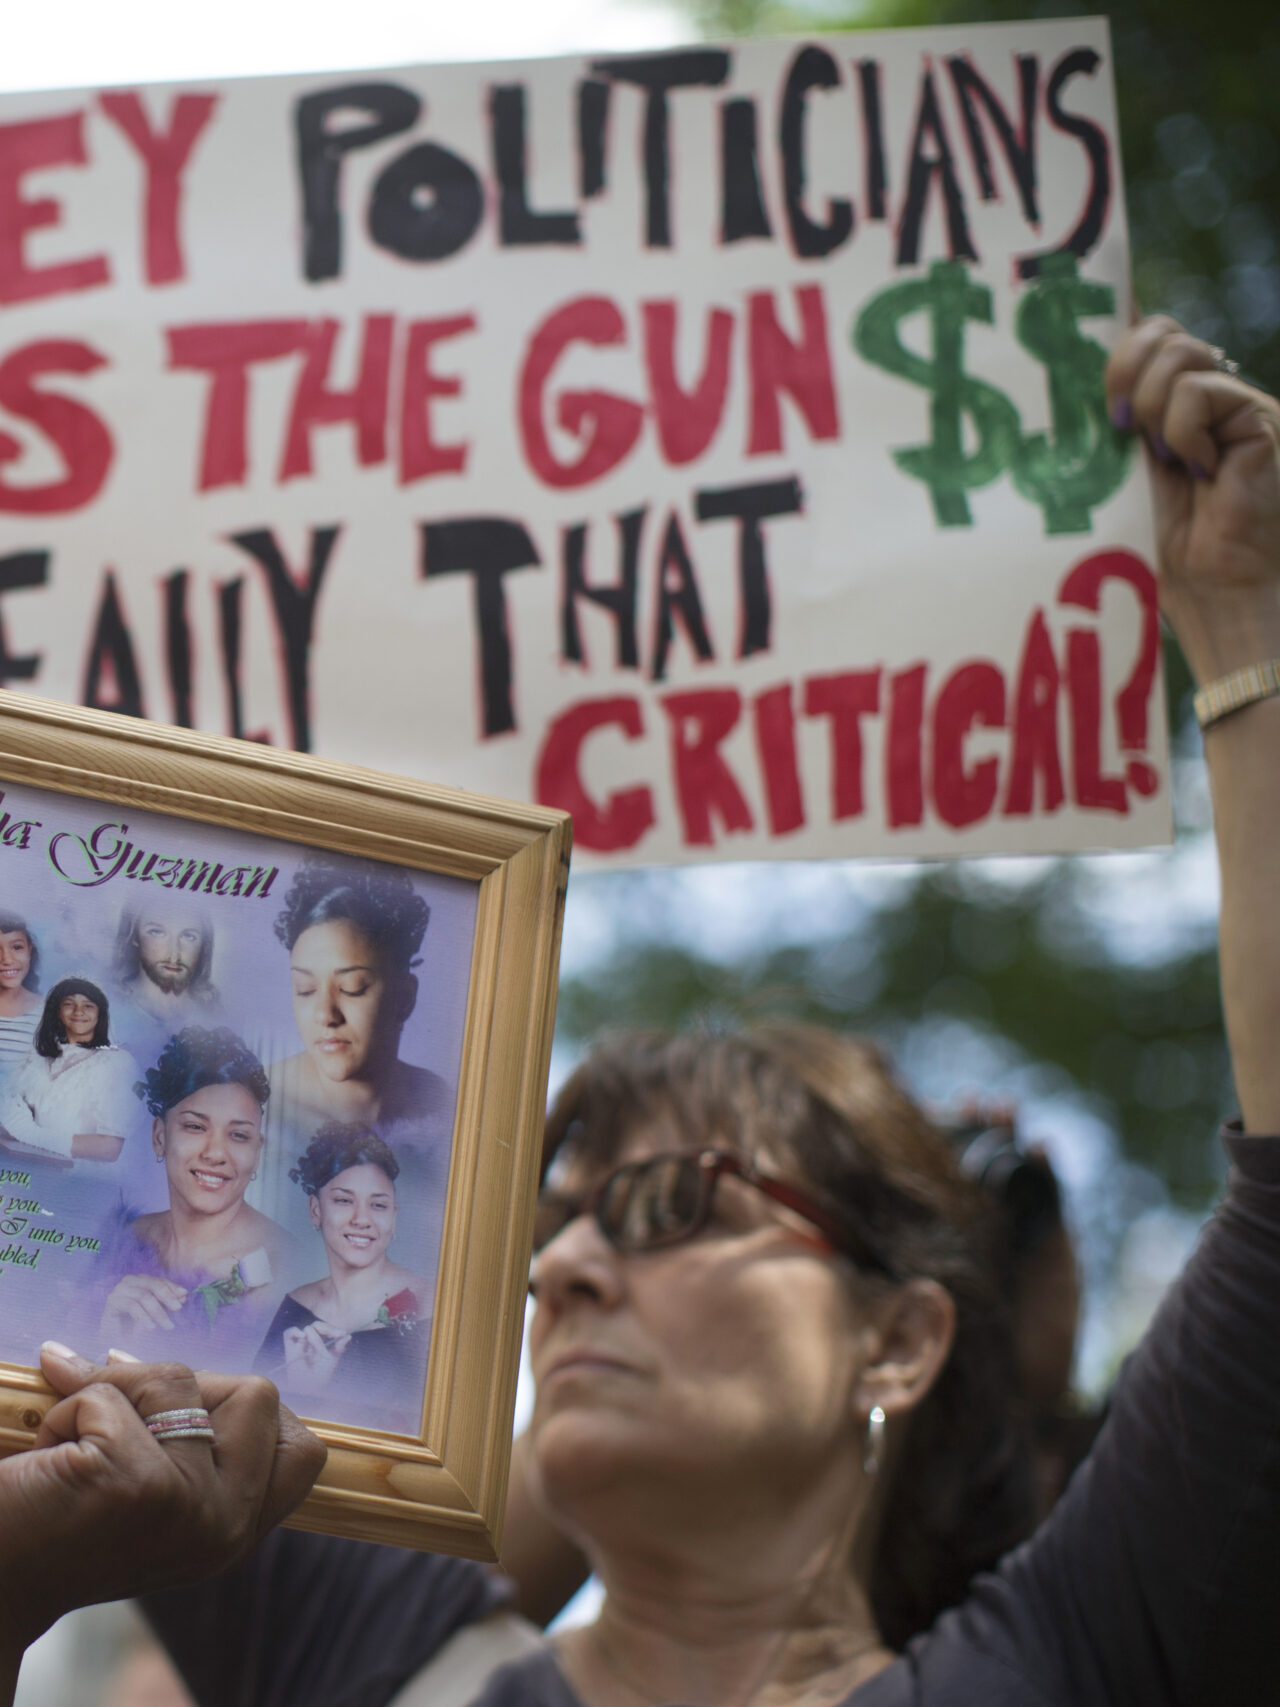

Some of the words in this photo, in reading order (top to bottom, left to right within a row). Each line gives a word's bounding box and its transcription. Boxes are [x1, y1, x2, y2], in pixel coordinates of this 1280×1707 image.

[292, 43, 1113, 285] POLITICIANS
[164, 311, 477, 494] THE
[517, 284, 841, 491] GUN
[853, 253, 1132, 536] $$
[418, 473, 803, 742] THAT
[47, 821, 279, 898] Guzman
[28, 1227, 65, 1244] unto
